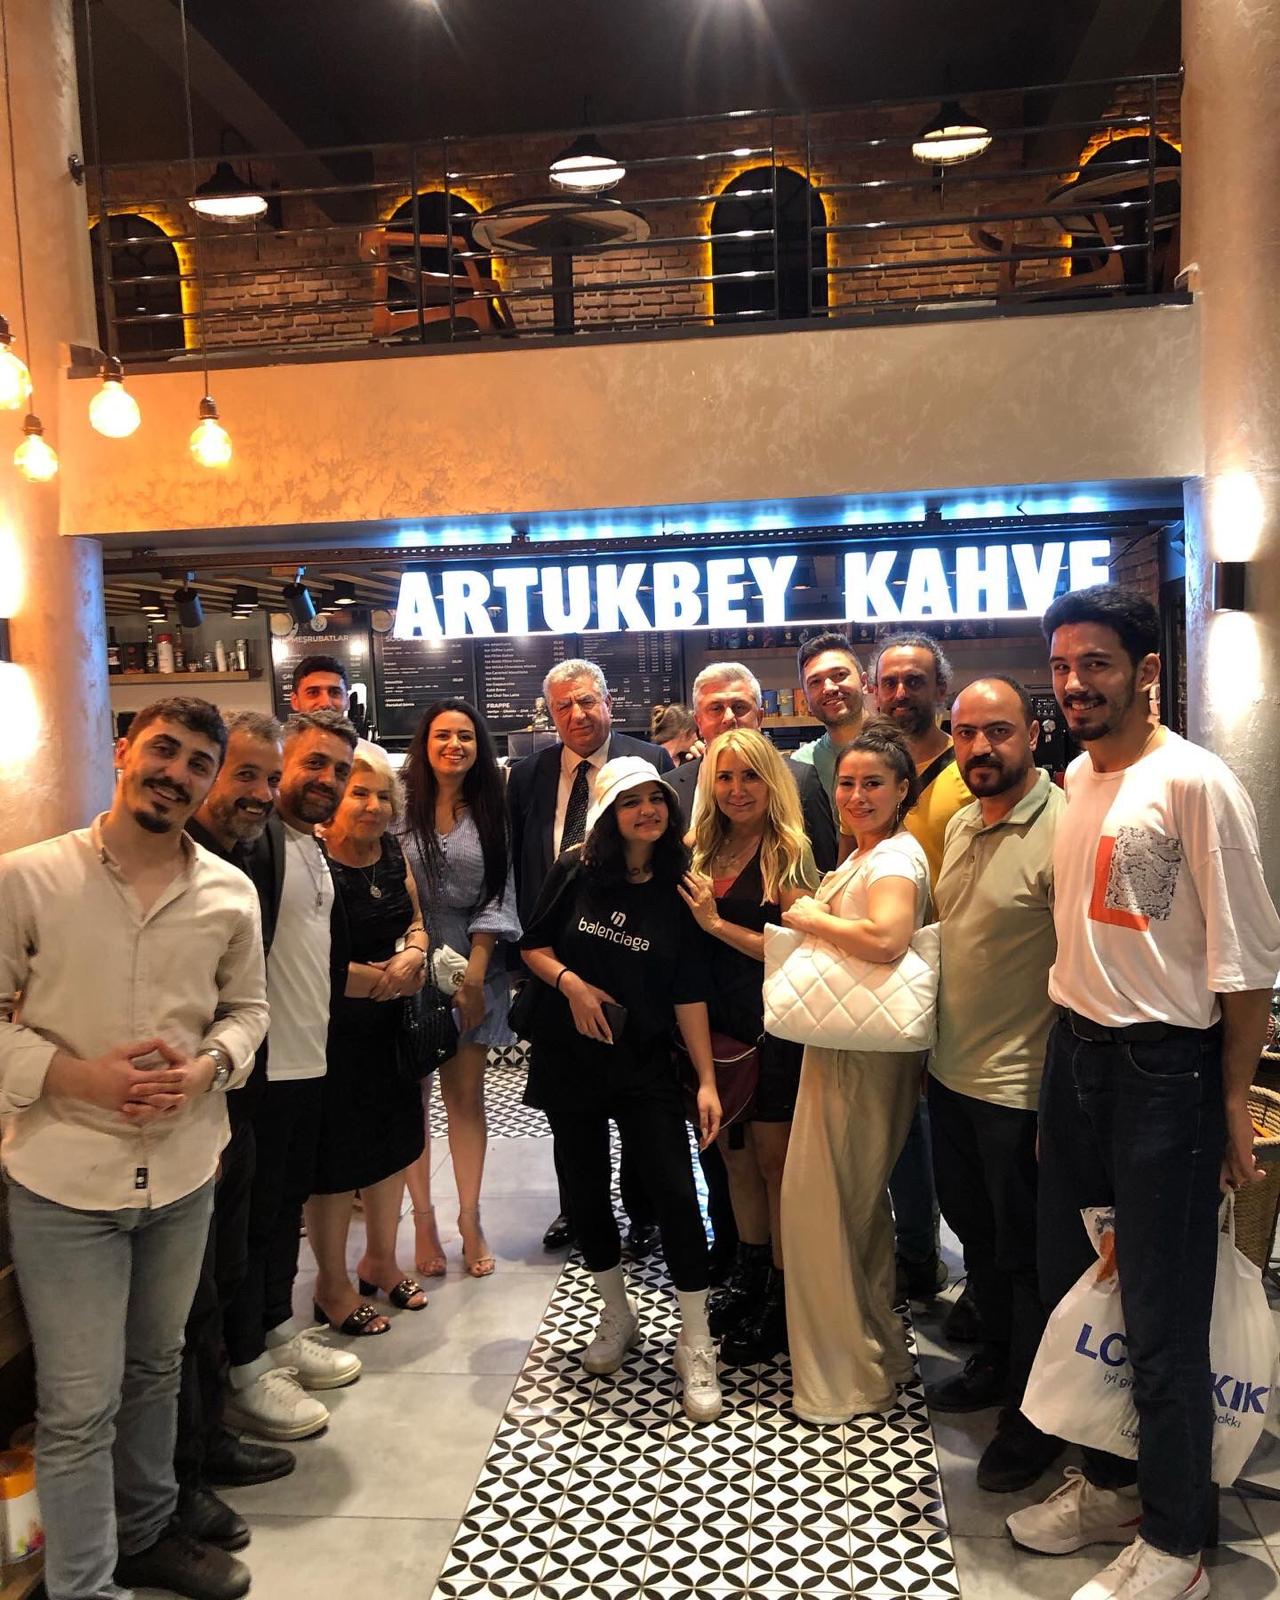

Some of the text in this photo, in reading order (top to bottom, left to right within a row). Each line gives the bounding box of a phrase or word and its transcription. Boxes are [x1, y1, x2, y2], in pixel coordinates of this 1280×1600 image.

[393, 553, 798, 640] ARTUKBEY
[578, 916, 650, 952] balenciaga
[1075, 1323, 1270, 1414] LC KIK
